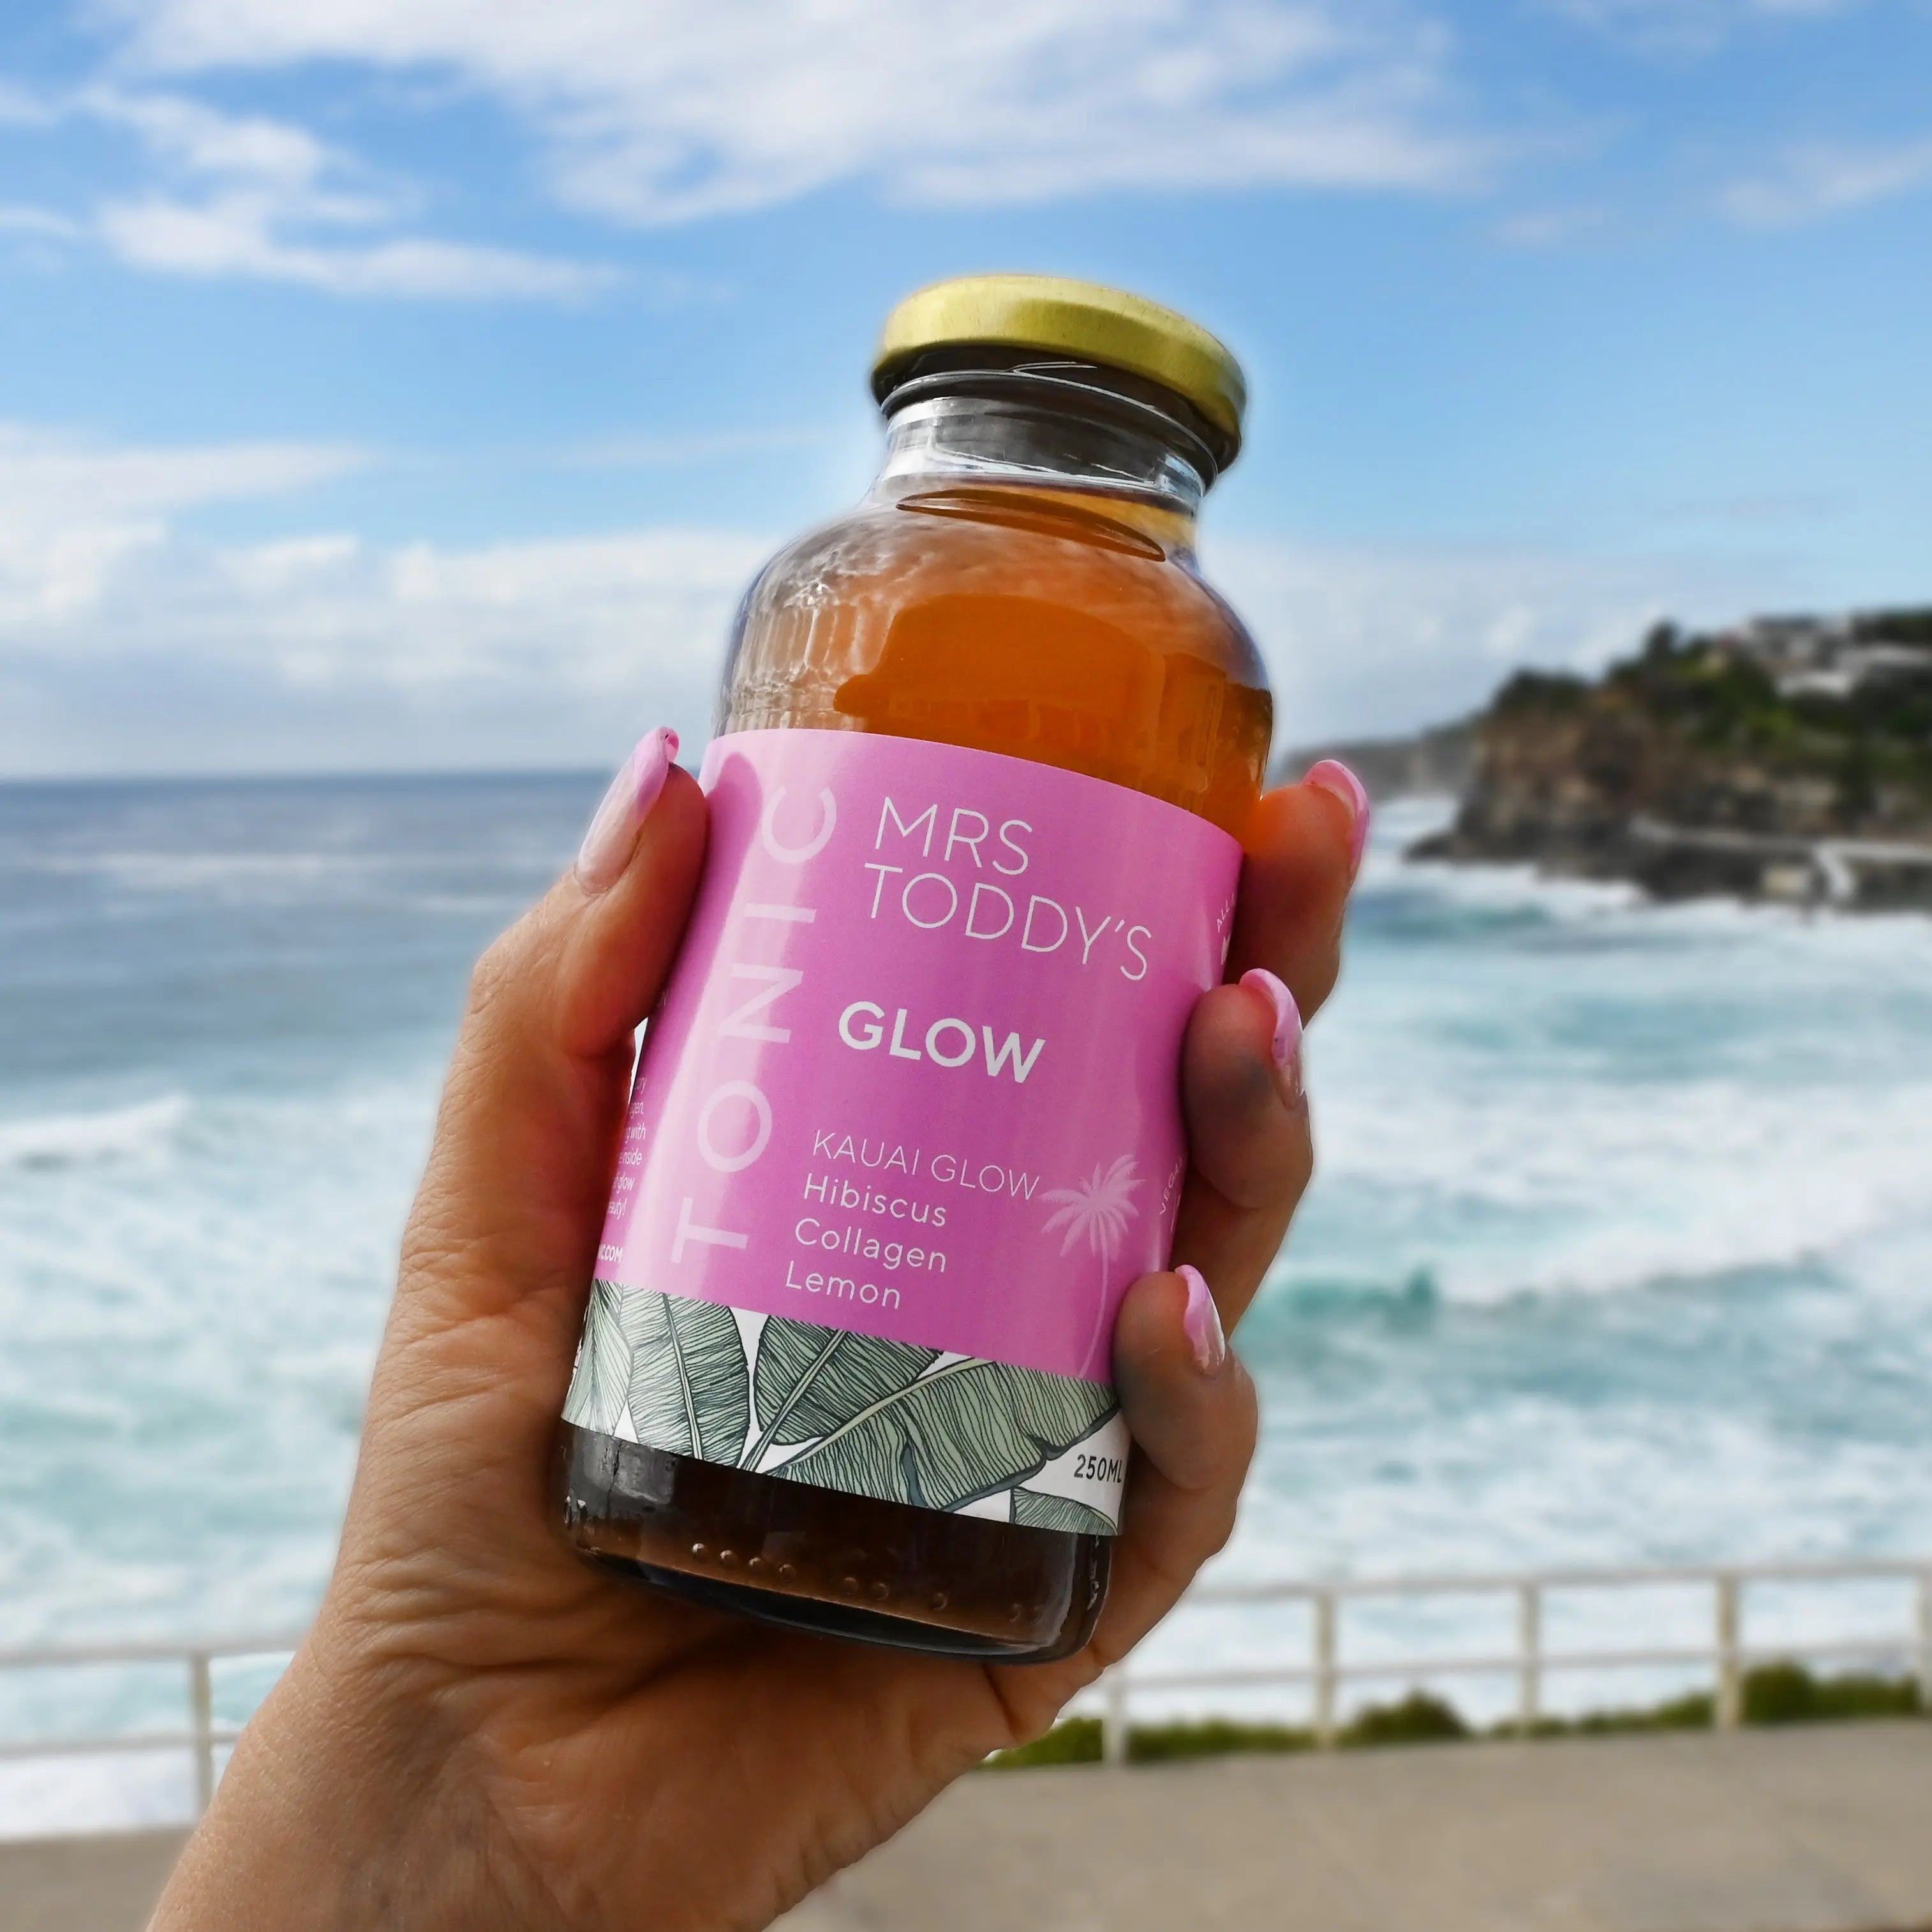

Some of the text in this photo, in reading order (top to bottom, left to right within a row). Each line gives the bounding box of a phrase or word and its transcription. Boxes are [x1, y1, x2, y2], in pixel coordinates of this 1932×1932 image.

[874, 796, 1033, 876] MRS
[864, 862, 1152, 981] TODDY'S
[671, 785, 837, 1263] TONIC
[838, 1000, 1046, 1083] GLOW
[803, 1172, 947, 1228] Hibiscus
[812, 1129, 1040, 1201] KAUAI GLOW
[794, 1217, 947, 1273] Collagen
[785, 1260, 901, 1310] Lemon
[1073, 1453, 1123, 1483] 250ML
